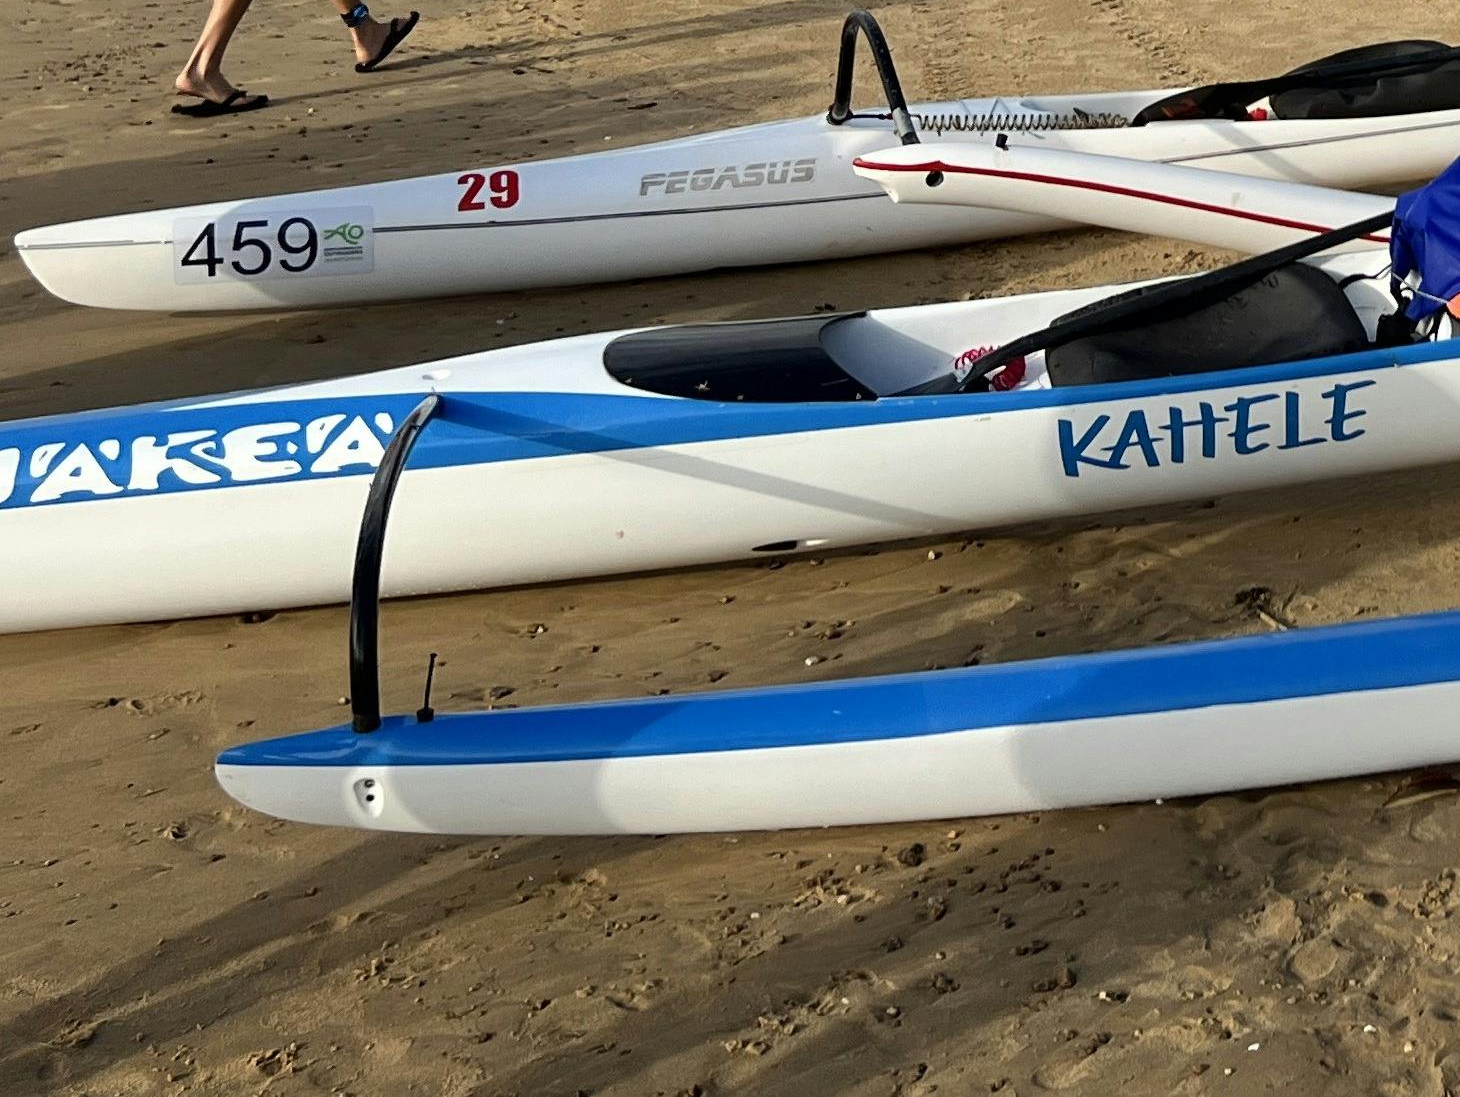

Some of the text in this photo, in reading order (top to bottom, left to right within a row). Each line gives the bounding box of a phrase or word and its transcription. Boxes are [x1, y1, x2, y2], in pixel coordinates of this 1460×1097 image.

[457, 170, 521, 213] 29
[640, 158, 818, 197] PEGASUS
[181, 218, 320, 278] 459
[1057, 379, 1377, 478] KAHELE
